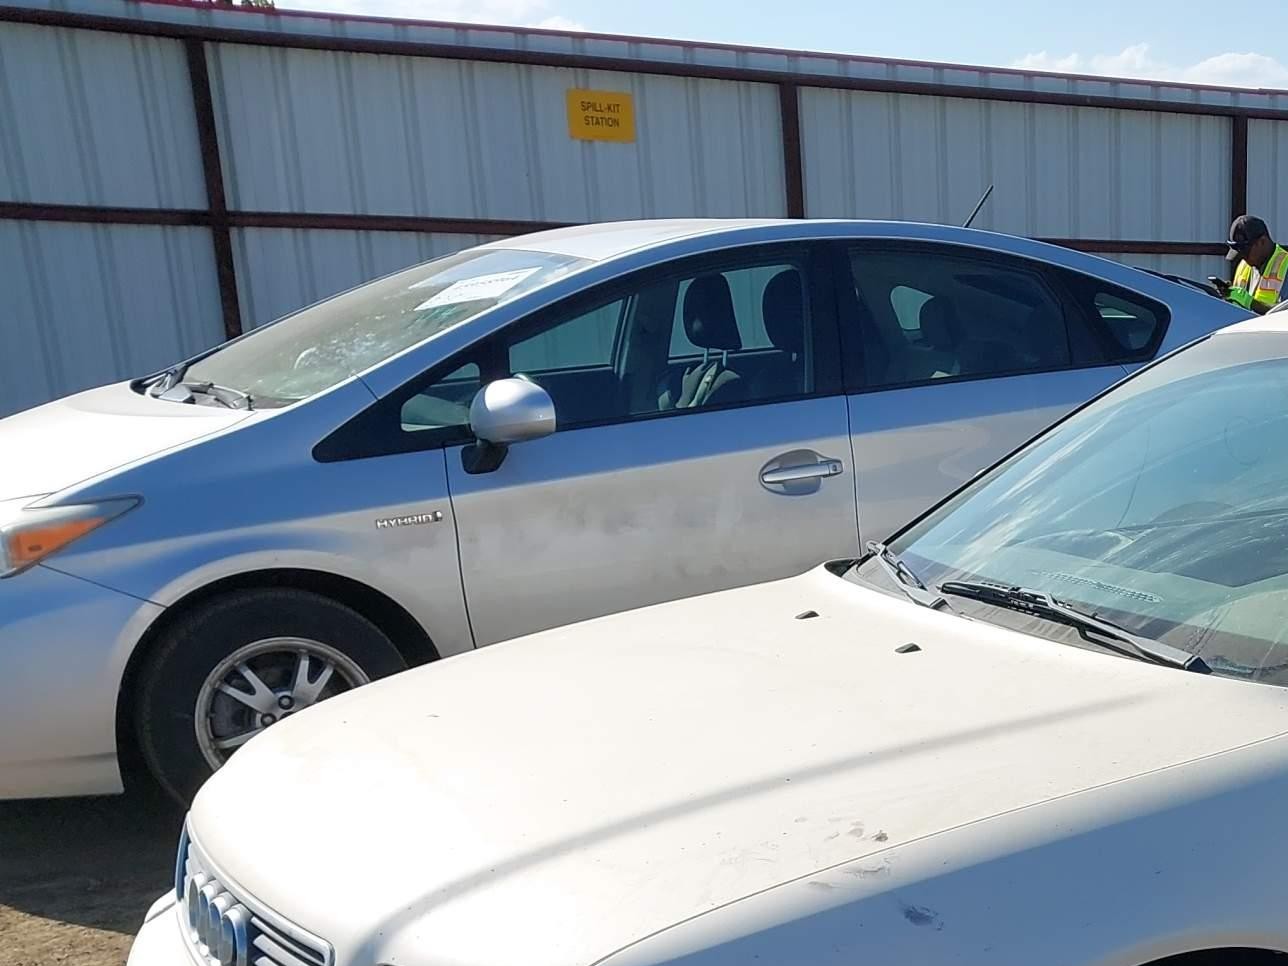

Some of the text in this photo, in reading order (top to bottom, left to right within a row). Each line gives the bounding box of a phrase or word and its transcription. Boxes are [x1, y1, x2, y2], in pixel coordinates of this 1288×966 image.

[580, 101, 620, 113] SPILL-KIT
[584, 115, 620, 128] STATION
[376, 513, 433, 529] HYBRID
